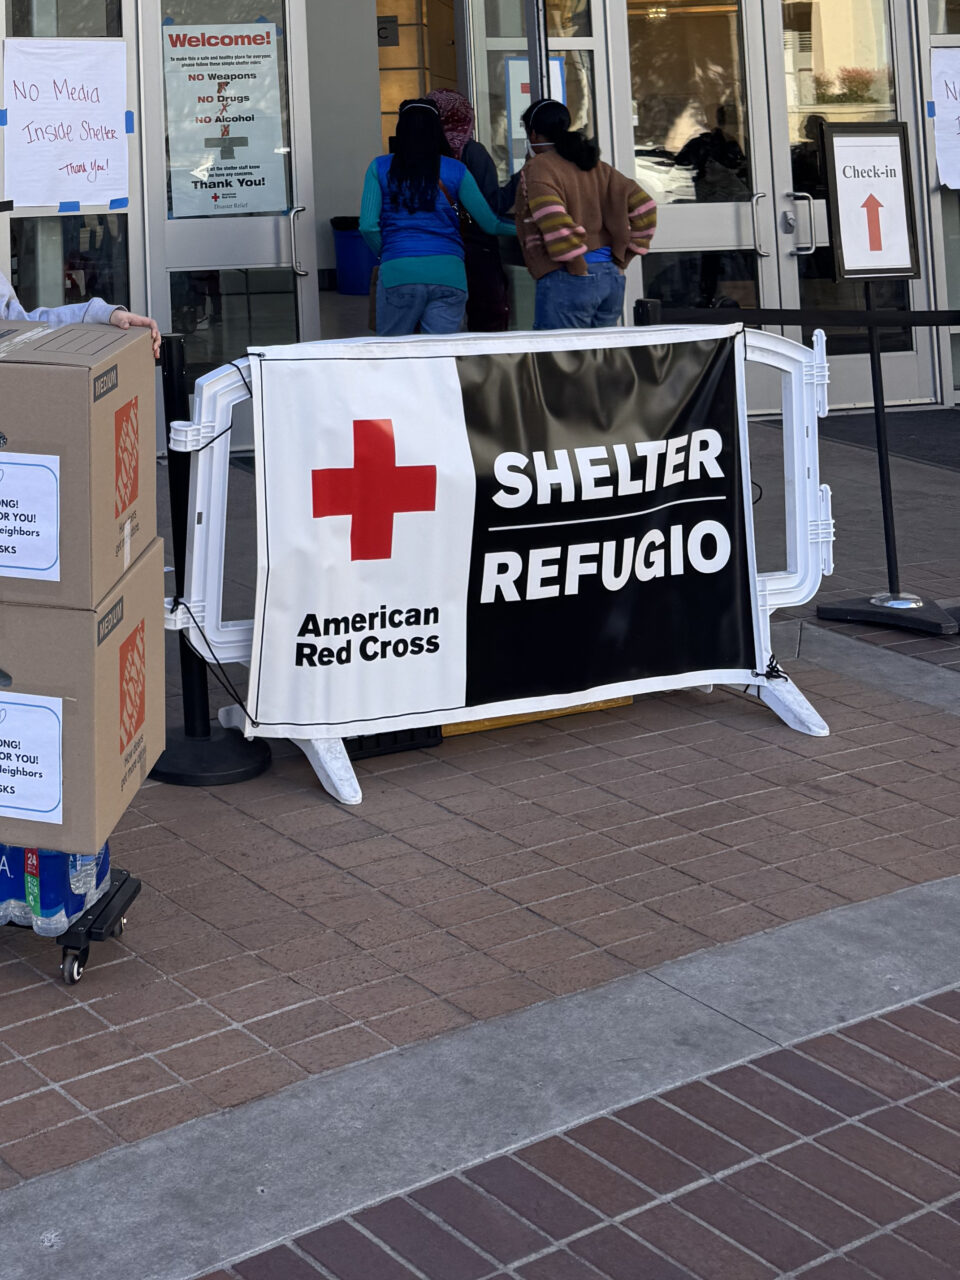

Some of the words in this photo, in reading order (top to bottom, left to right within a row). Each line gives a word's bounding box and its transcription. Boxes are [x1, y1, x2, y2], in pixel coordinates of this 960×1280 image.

[168, 31, 272, 48] Welcome!
[208, 73, 257, 82] Weapons
[52, 78, 100, 104] Media
[217, 95, 250, 104] Drugs
[214, 114, 255, 124] Alcohol
[22, 120, 74, 144] Inside
[58, 162, 88, 176] Thank
[842, 164, 897, 178] Check-in
[192, 180, 234, 190] Thank
[237, 178, 266, 188] You!
[95, 370, 117, 396] MEDIUM
[492, 428, 726, 508] SHELTER
[12, 513, 36, 524] YOU!
[480, 520, 731, 604] REFUGIO
[297, 604, 439, 638] American
[295, 639, 352, 667] Red
[359, 635, 440, 662] Cross
[14, 753, 39, 764] YOU!
[27, 852, 37, 866] 24
